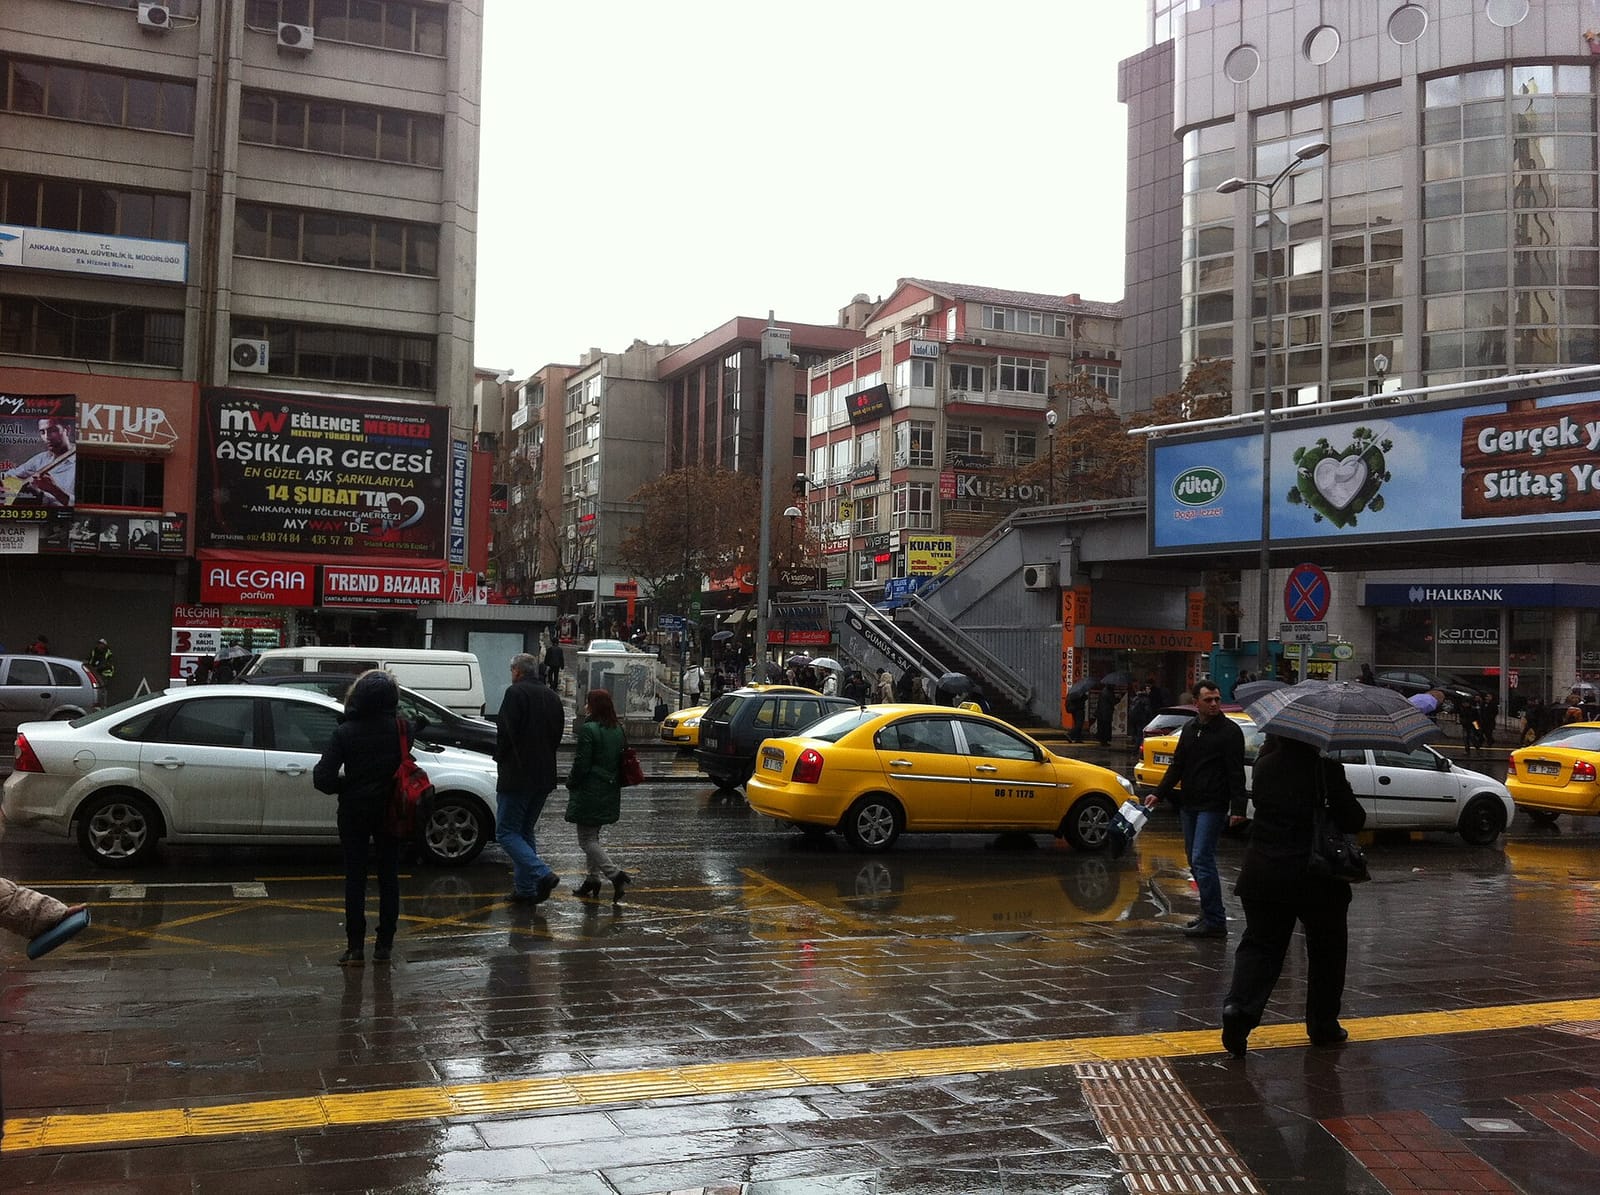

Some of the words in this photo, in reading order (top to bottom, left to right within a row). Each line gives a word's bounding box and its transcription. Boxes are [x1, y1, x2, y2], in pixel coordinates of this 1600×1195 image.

[29, 243, 61, 253] ANKARA
[61, 246, 90, 256] SOSYAL
[91, 249, 127, 259] GÜVENLİK
[913, 344, 938, 356] AutoCAD
[291, 411, 361, 433] EĞLENCE
[364, 420, 432, 439] MERKEZİ
[291, 429, 322, 439] MEKTUP
[1477, 415, 1579, 456] Gerçek
[216, 440, 334, 466] AŞIKLAR
[341, 448, 433, 474] GECESİ
[243, 466, 261, 477] EN
[263, 466, 302, 480] GÜZEL
[304, 469, 334, 485] AŞK
[336, 473, 415, 488] ŞARKILARIYLA
[1483, 469, 1564, 501] Sütaş
[265, 484, 290, 501] 14
[453, 459, 467, 527] ÇERÇEVE
[1178, 475, 1220, 497] sütaş
[21, 510, 33, 519] 59
[35, 510, 48, 519] 59
[314, 507, 360, 518] EĞLENCE
[360, 510, 402, 520] MERKEZİ
[7, 528, 26, 536] CAR
[260, 531, 277, 542] 430
[277, 532, 288, 543] 74
[289, 533, 301, 543] 84
[311, 534, 327, 544] 435
[330, 536, 341, 545] 57
[343, 536, 354, 546] 78
[909, 539, 952, 551] KUAFÖR
[209, 568, 306, 590] ALEGRIA
[328, 573, 380, 592] TREND
[383, 575, 441, 595] BAZAAR
[240, 590, 275, 601] parfüm
[1426, 588, 1503, 601] HALKBANK
[175, 606, 220, 618] ALEGRIA
[176, 631, 192, 653] 3
[1095, 633, 1156, 646] ALTINKOZA
[179, 656, 199, 679] 5
[994, 788, 1006, 798] 06
[1008, 789, 1013, 798] T
[1016, 789, 1035, 799] 1175
